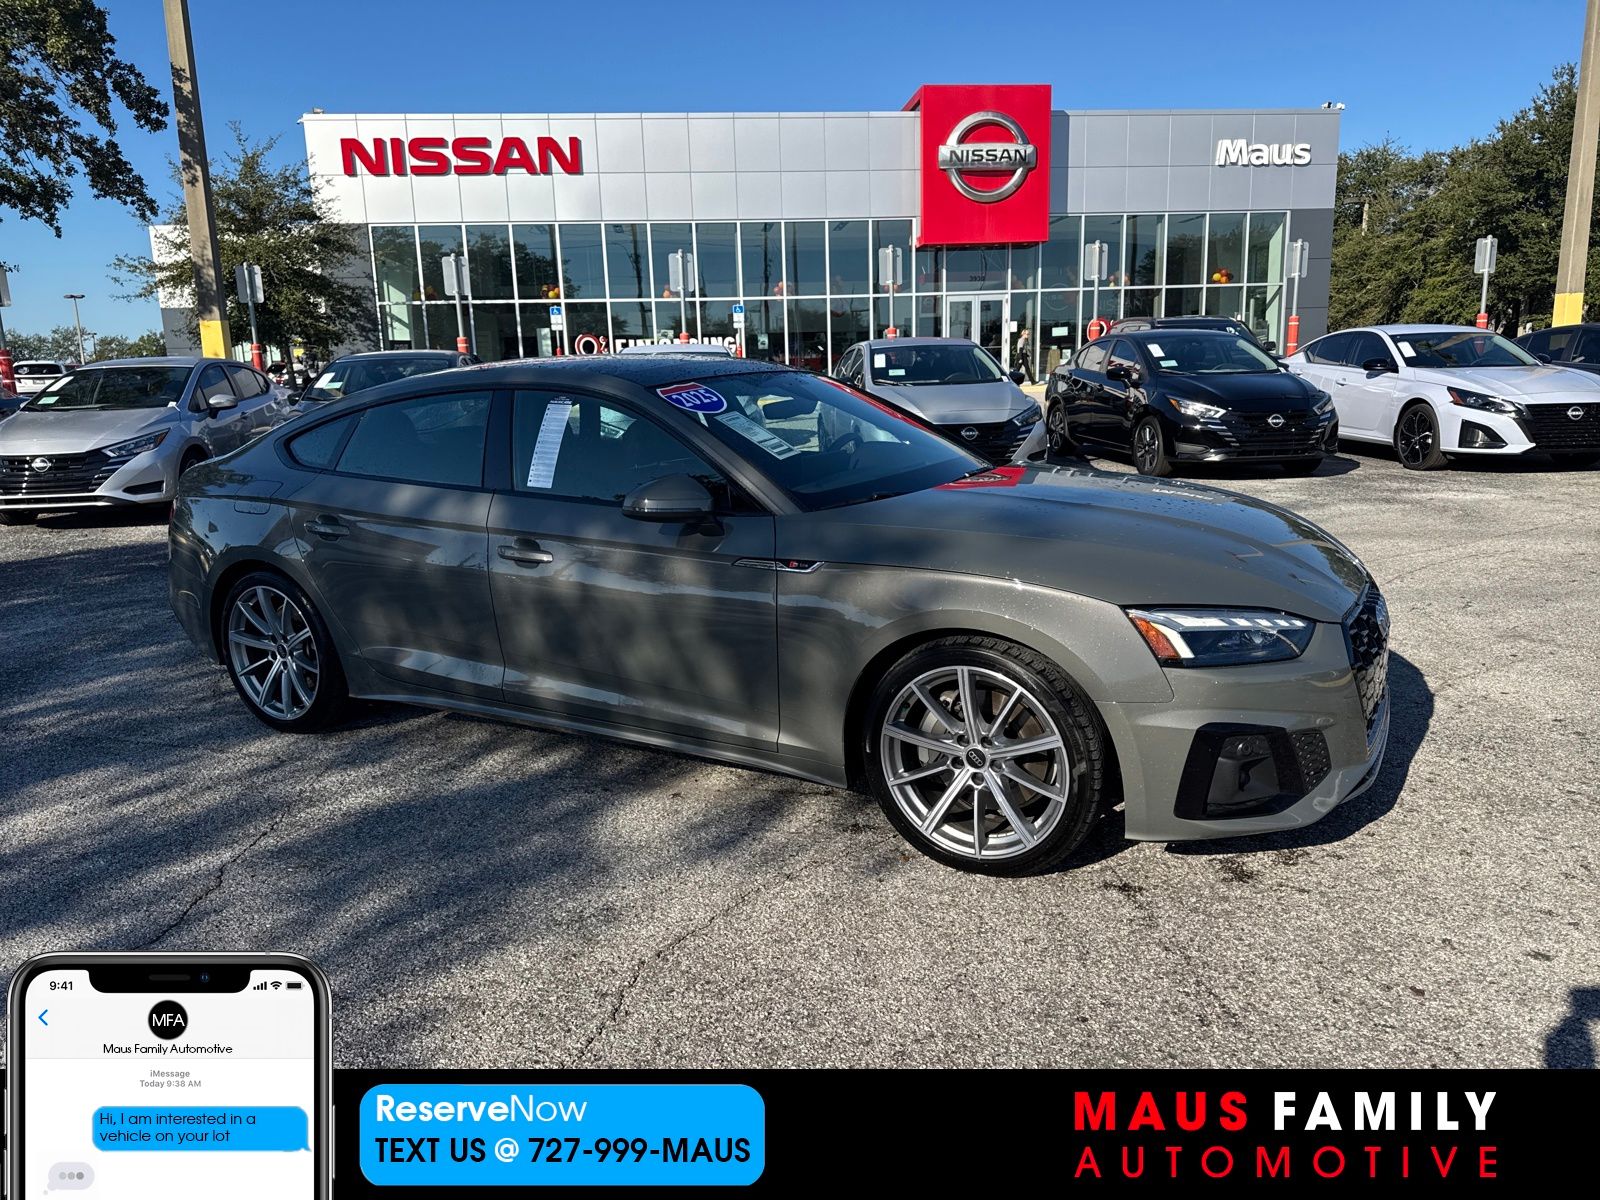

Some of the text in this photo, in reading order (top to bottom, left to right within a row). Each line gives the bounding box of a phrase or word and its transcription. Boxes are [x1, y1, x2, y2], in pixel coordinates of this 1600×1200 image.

[340, 136, 583, 177] NISSAN
[949, 149, 1027, 163] NISSAN
[1215, 138, 1311, 167] Maus
[671, 389, 718, 407] 2025
